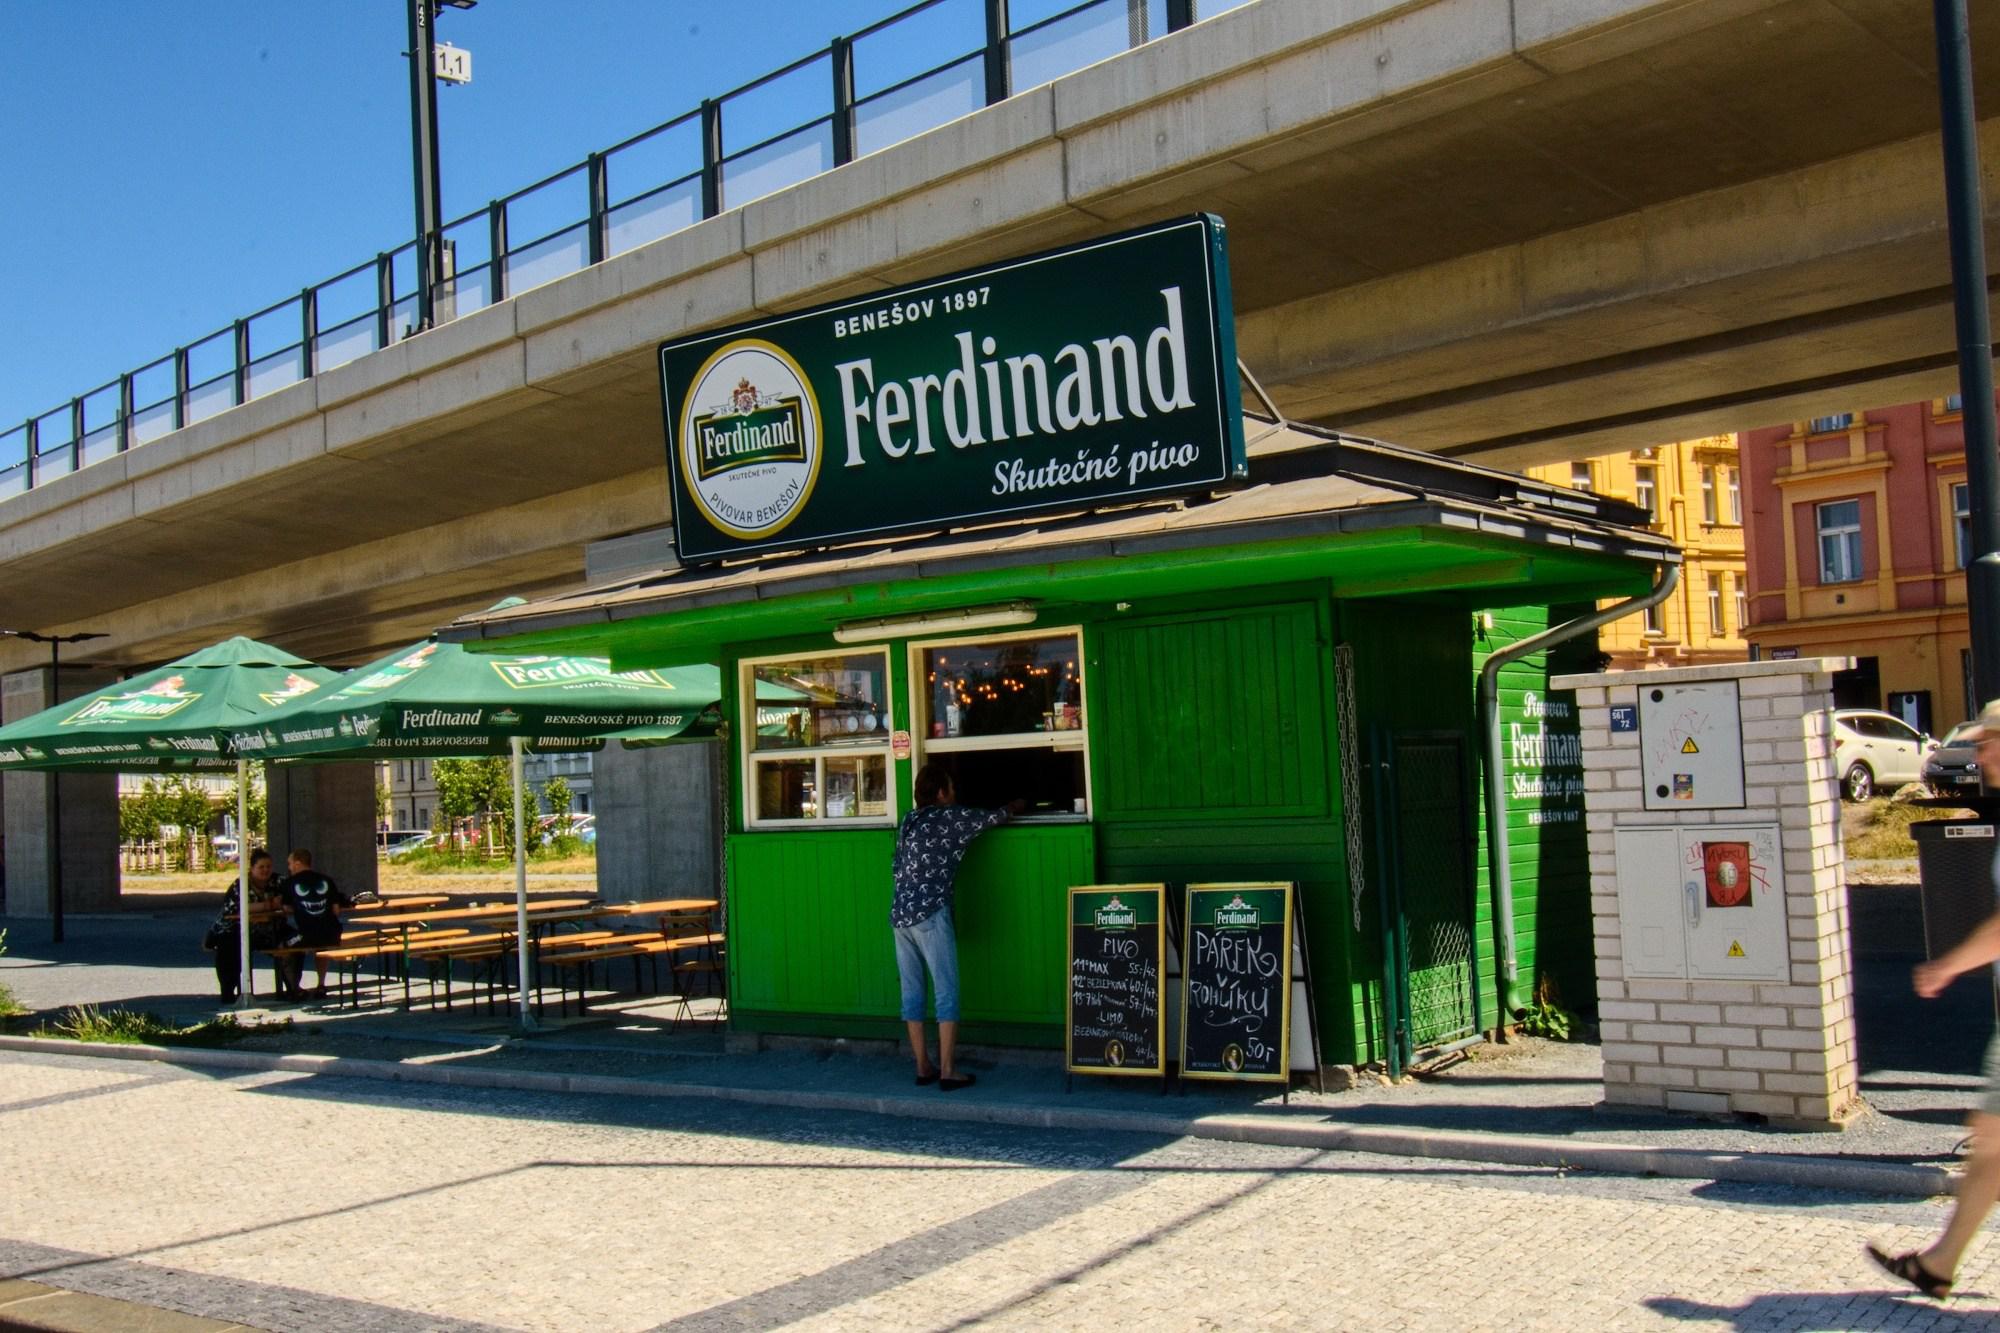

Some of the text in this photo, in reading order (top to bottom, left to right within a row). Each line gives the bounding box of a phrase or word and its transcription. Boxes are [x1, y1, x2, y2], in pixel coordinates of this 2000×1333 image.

[439, 51, 463, 75] 1,1
[834, 286, 991, 338] BENEŠOV 1897
[835, 286, 1196, 468] Ferdinand
[703, 411, 796, 460] Ferdinand
[728, 467, 777, 482] SKUTEČNÉ PIVO
[991, 440, 1199, 496] Skutečné pivo
[710, 478, 800, 523] PIVOVAR BENEŠOV
[1523, 691, 1569, 718] Pivovar
[402, 709, 482, 729] Ferdinand
[544, 712, 624, 725] BENEŠOVSKÉ
[626, 714, 654, 725] PIVO
[656, 715, 683, 726] 1897
[1512, 772, 1562, 799] Skutečné
[1528, 809, 1561, 824] BENEŠOV
[1097, 911, 1134, 926] Ferdinand
[1217, 911, 1257, 925] Ferdinand
[1103, 937, 1139, 959] PIVO
